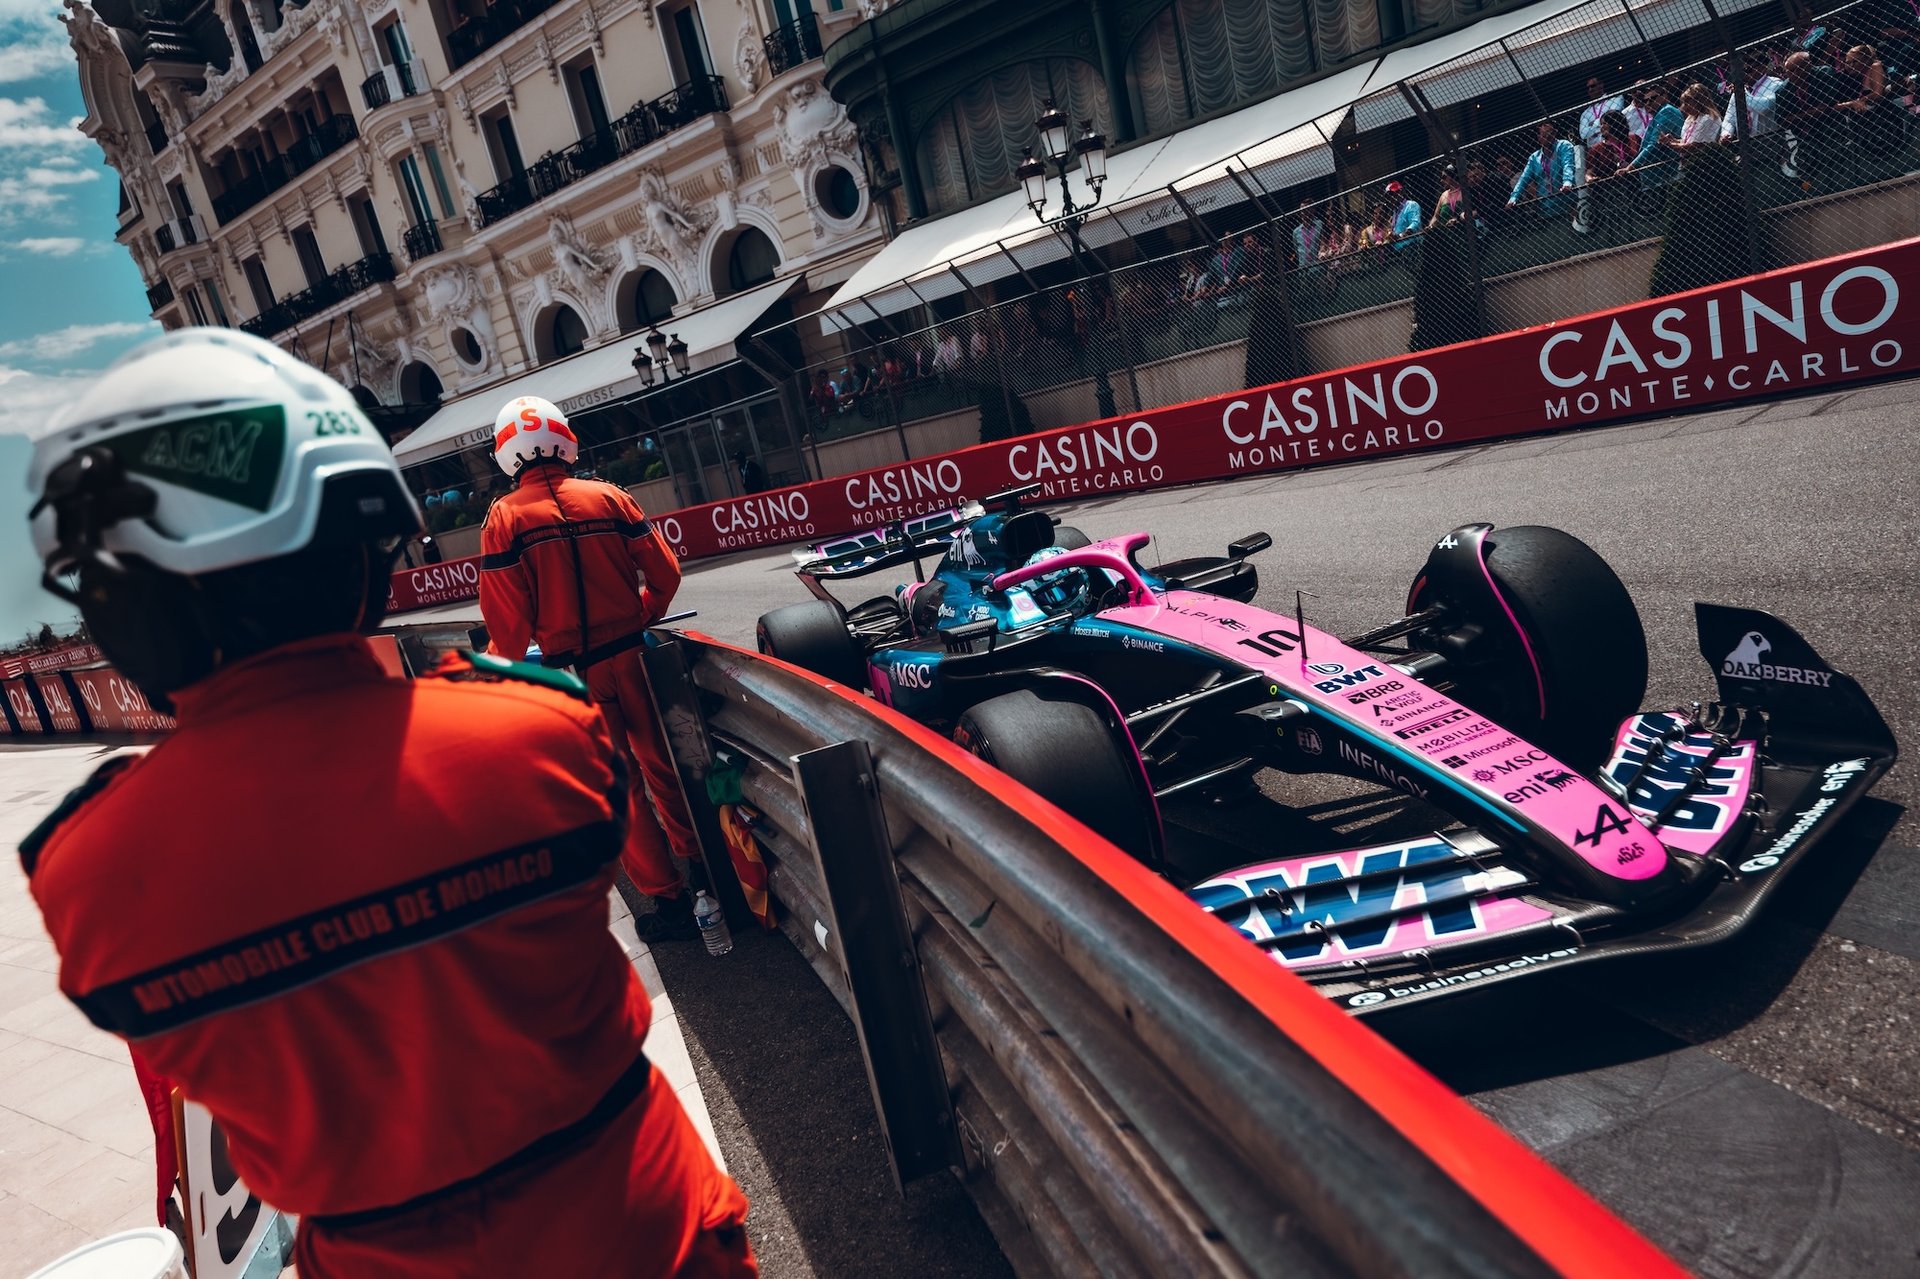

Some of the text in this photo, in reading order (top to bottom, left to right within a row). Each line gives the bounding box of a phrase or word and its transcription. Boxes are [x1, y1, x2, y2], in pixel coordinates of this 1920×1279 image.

[1539, 265, 1899, 388] CASINO
[1545, 339, 1902, 420] MONTE CARLO
[454, 435, 468, 448] LE
[562, 388, 616, 414] DUCASSE
[519, 407, 543, 432] S
[1222, 365, 1438, 445] CASINO
[306, 409, 361, 437] 283
[142, 419, 262, 482] ACM
[1008, 421, 1158, 481] CASINO
[1228, 420, 1444, 469] MONTE CARLO
[845, 459, 962, 509] CASINO
[1095, 465, 1164, 490] CARLO
[711, 490, 809, 535] CASINO
[852, 506, 905, 526] MONTE
[718, 521, 815, 549] MONTE CARLO
[411, 562, 478, 593] CASINO
[417, 588, 448, 603] MONTE
[1131, 639, 1164, 653] BINANCE
[1237, 629, 1301, 658] 10
[895, 662, 932, 689] MSC
[1312, 664, 1386, 694] BWT
[1722, 659, 1834, 688] OAKBERRY
[1365, 680, 1405, 699] BRB
[1385, 690, 1421, 706] ARCTIC
[1395, 696, 1423, 709] WOLF
[1393, 708, 1473, 740] PIRELLI
[1394, 700, 1450, 722] BINANCE
[1427, 727, 1498, 756] FINANCIAL SERVICES
[1463, 735, 1521, 761] Microsoft
[1491, 749, 1550, 777] MSC
[1502, 775, 1545, 805] eni
[132, 847, 554, 1014] AUTOMOBILE CLUB DE MONACO
[1389, 945, 1581, 1000] businessolver
